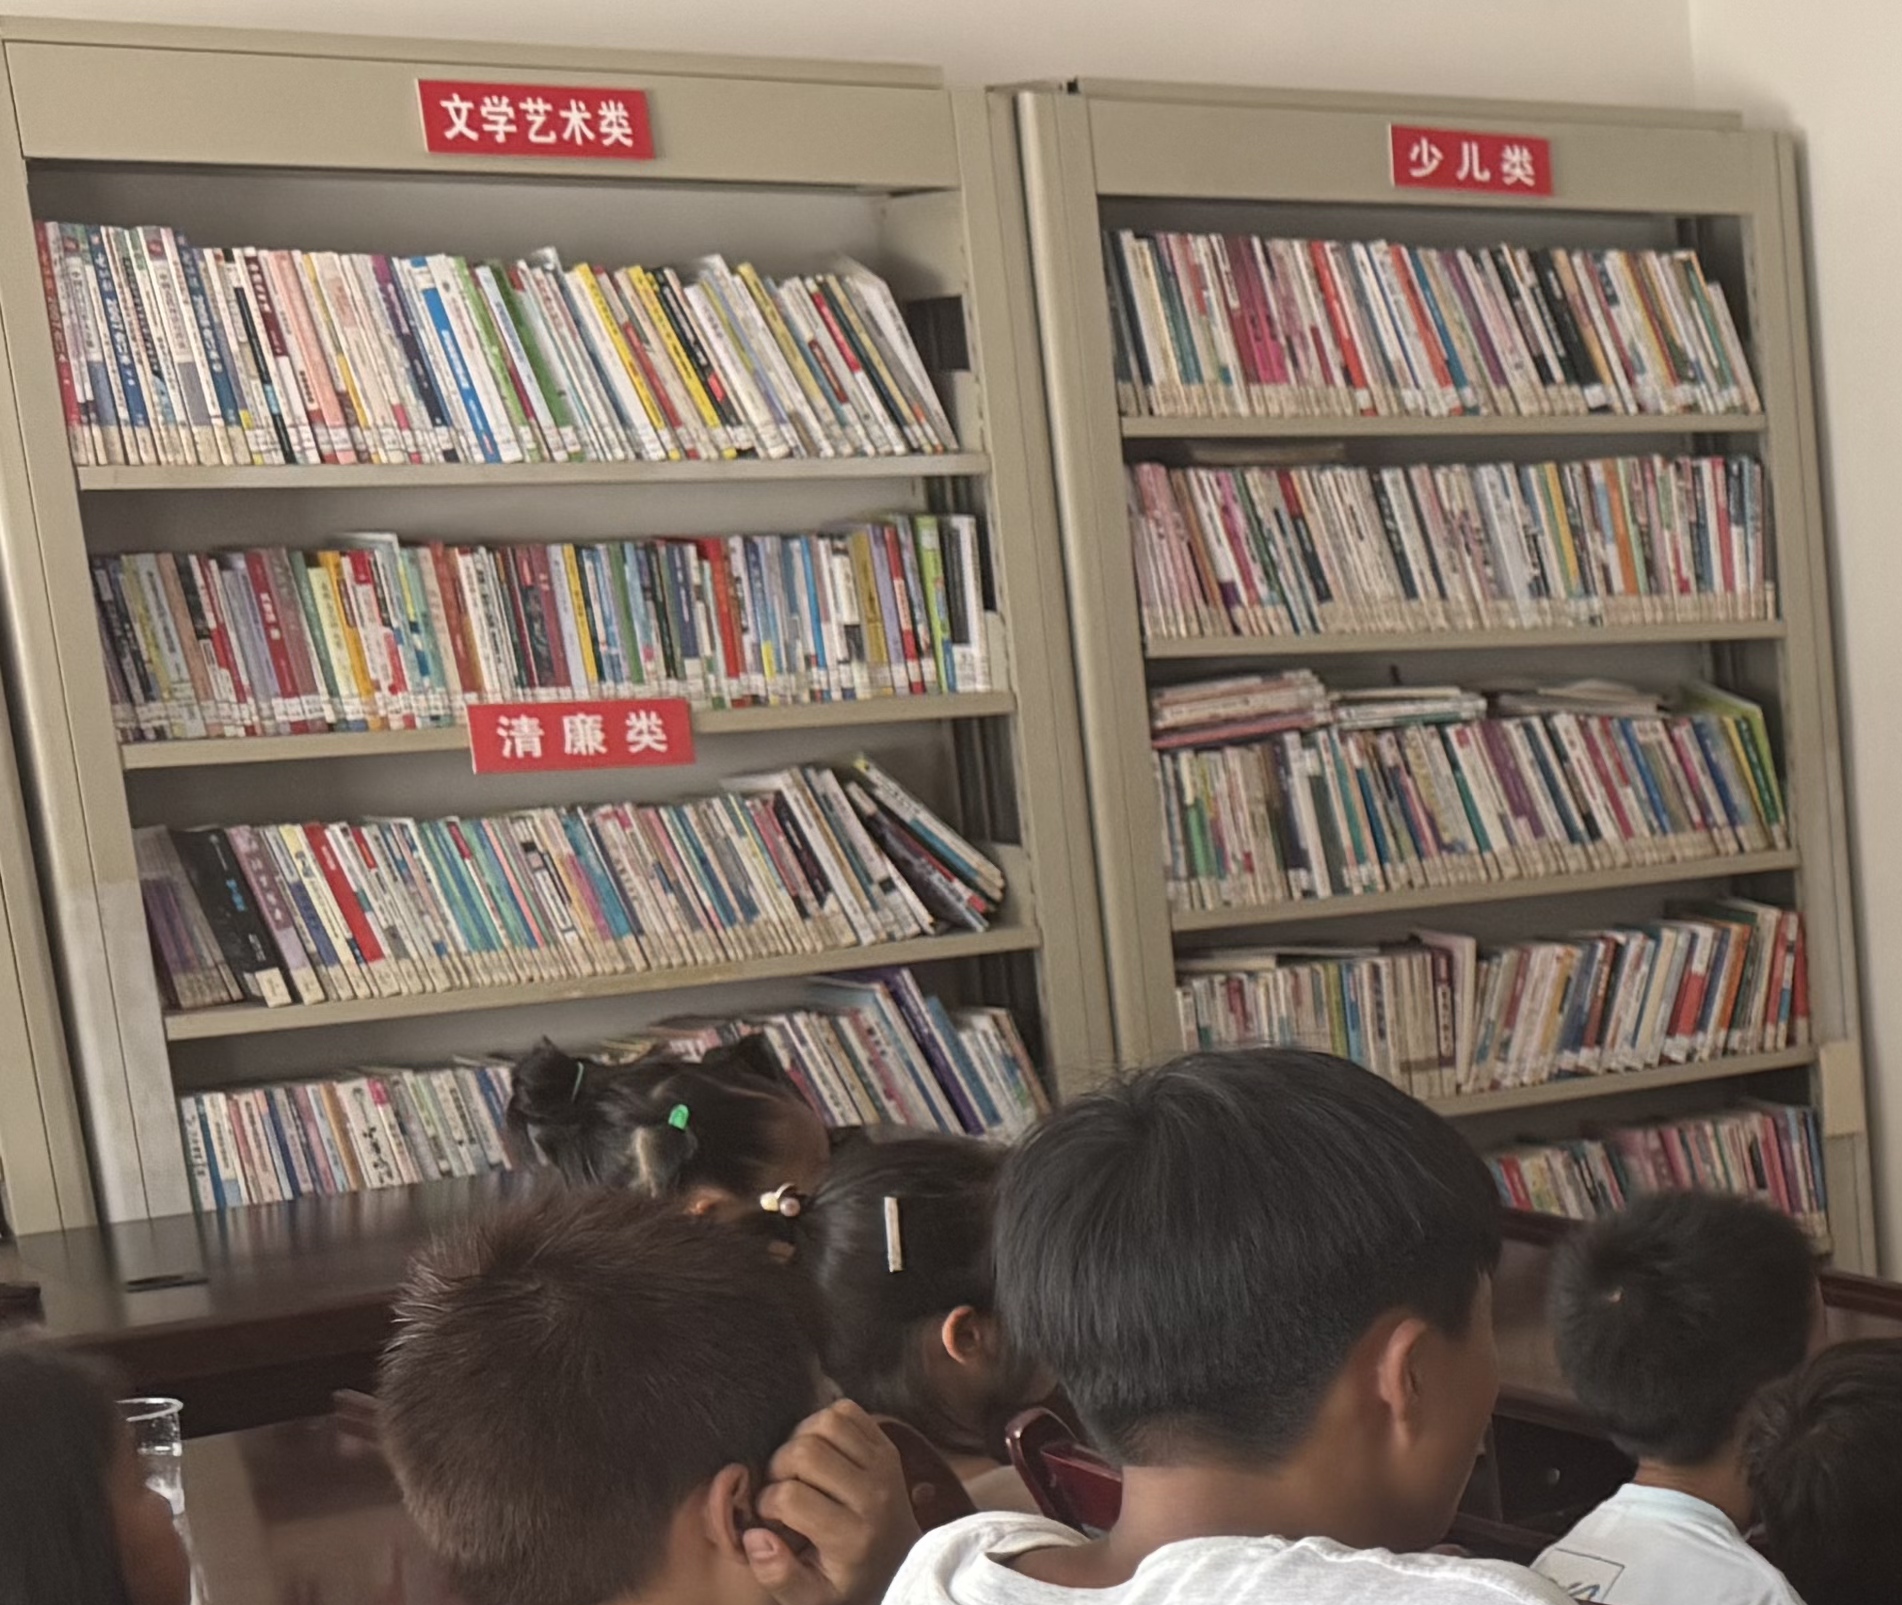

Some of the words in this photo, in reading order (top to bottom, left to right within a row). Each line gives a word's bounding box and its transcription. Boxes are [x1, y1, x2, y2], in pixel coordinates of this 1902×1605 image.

[440, 93, 634, 148] 文学艺术类
[1409, 136, 1536, 187] 少儿类
[496, 709, 668, 758] 清廉类
